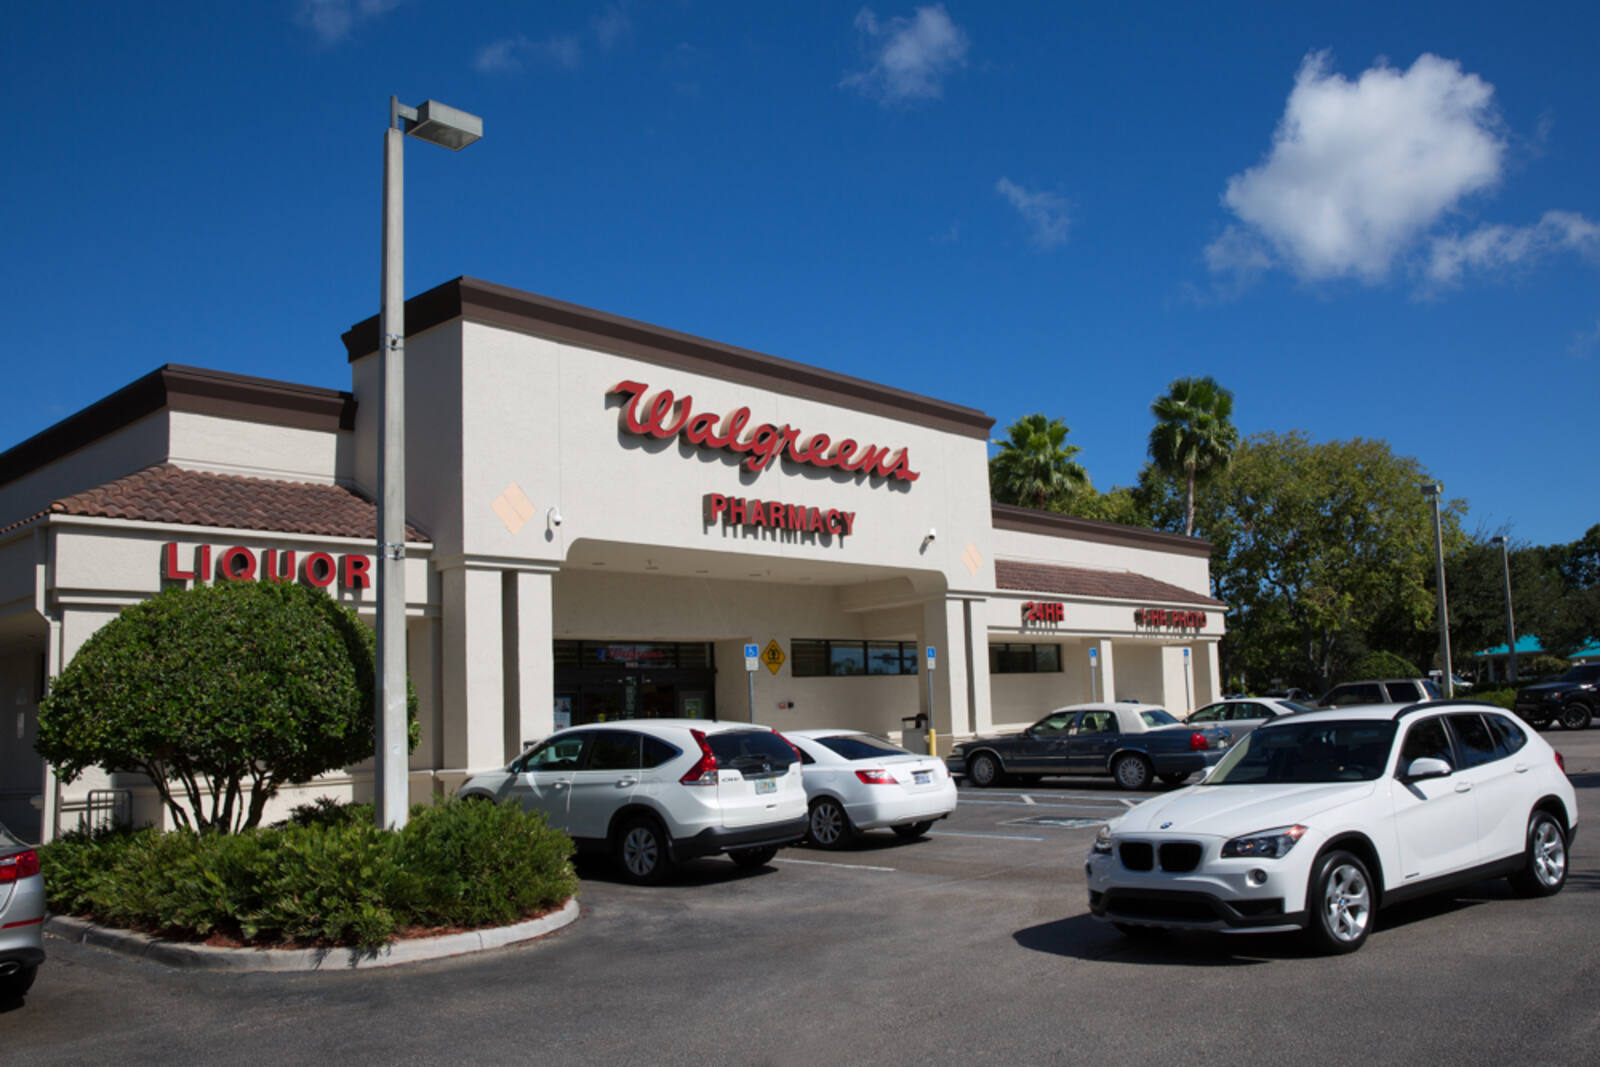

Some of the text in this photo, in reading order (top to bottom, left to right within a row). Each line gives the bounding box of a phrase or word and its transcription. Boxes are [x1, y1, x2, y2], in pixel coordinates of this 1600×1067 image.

[615, 380, 920, 481] Walgreens
[711, 493, 856, 536] PHARMACY
[167, 542, 371, 588] LIQUOR
